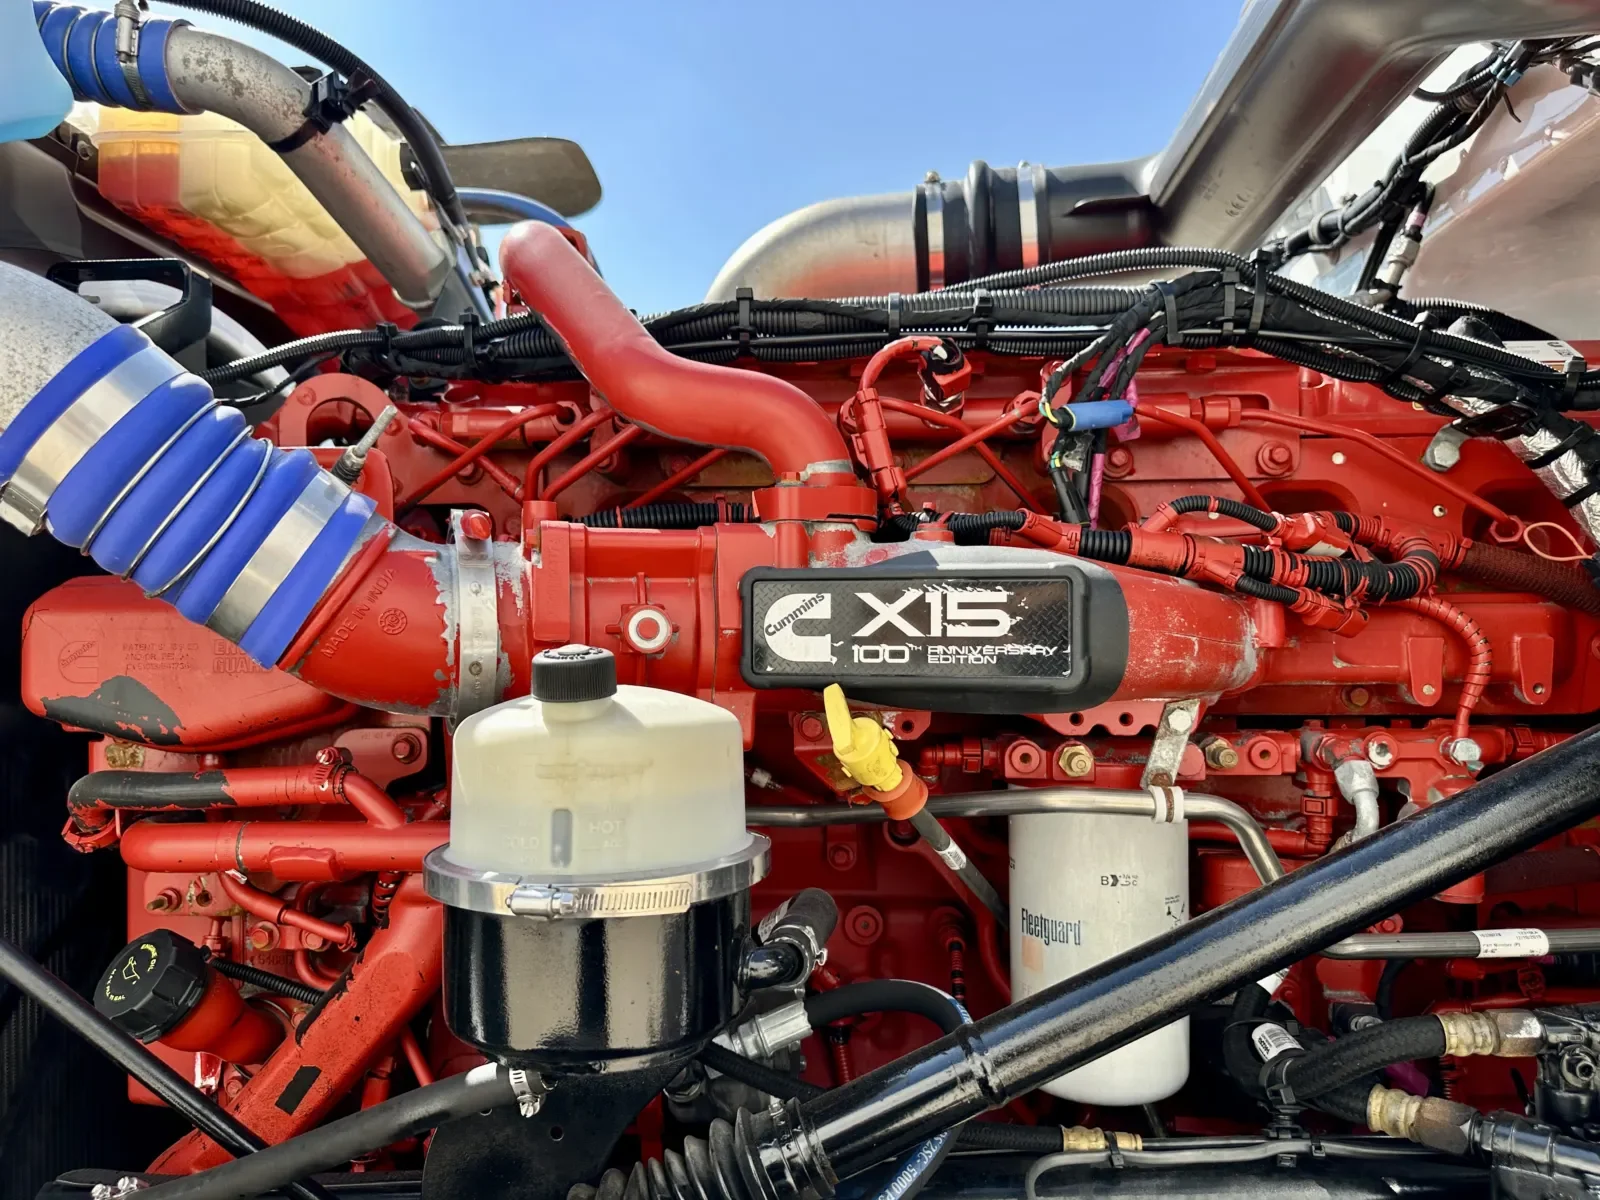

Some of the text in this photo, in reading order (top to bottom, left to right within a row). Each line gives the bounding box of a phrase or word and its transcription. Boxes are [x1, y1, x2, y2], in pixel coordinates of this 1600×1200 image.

[320, 569, 396, 659] MADE IN INDIA
[765, 592, 825, 637] Cummins
[851, 590, 1012, 637] X15
[928, 645, 1058, 656] ANNIVERSARY
[928, 655, 997, 664] EDITION
[589, 820, 624, 835] HOT
[1021, 907, 1081, 946] Fleetguard
[147, 958, 156, 972] OIL
[891, 1163, 918, 1194] 5000
